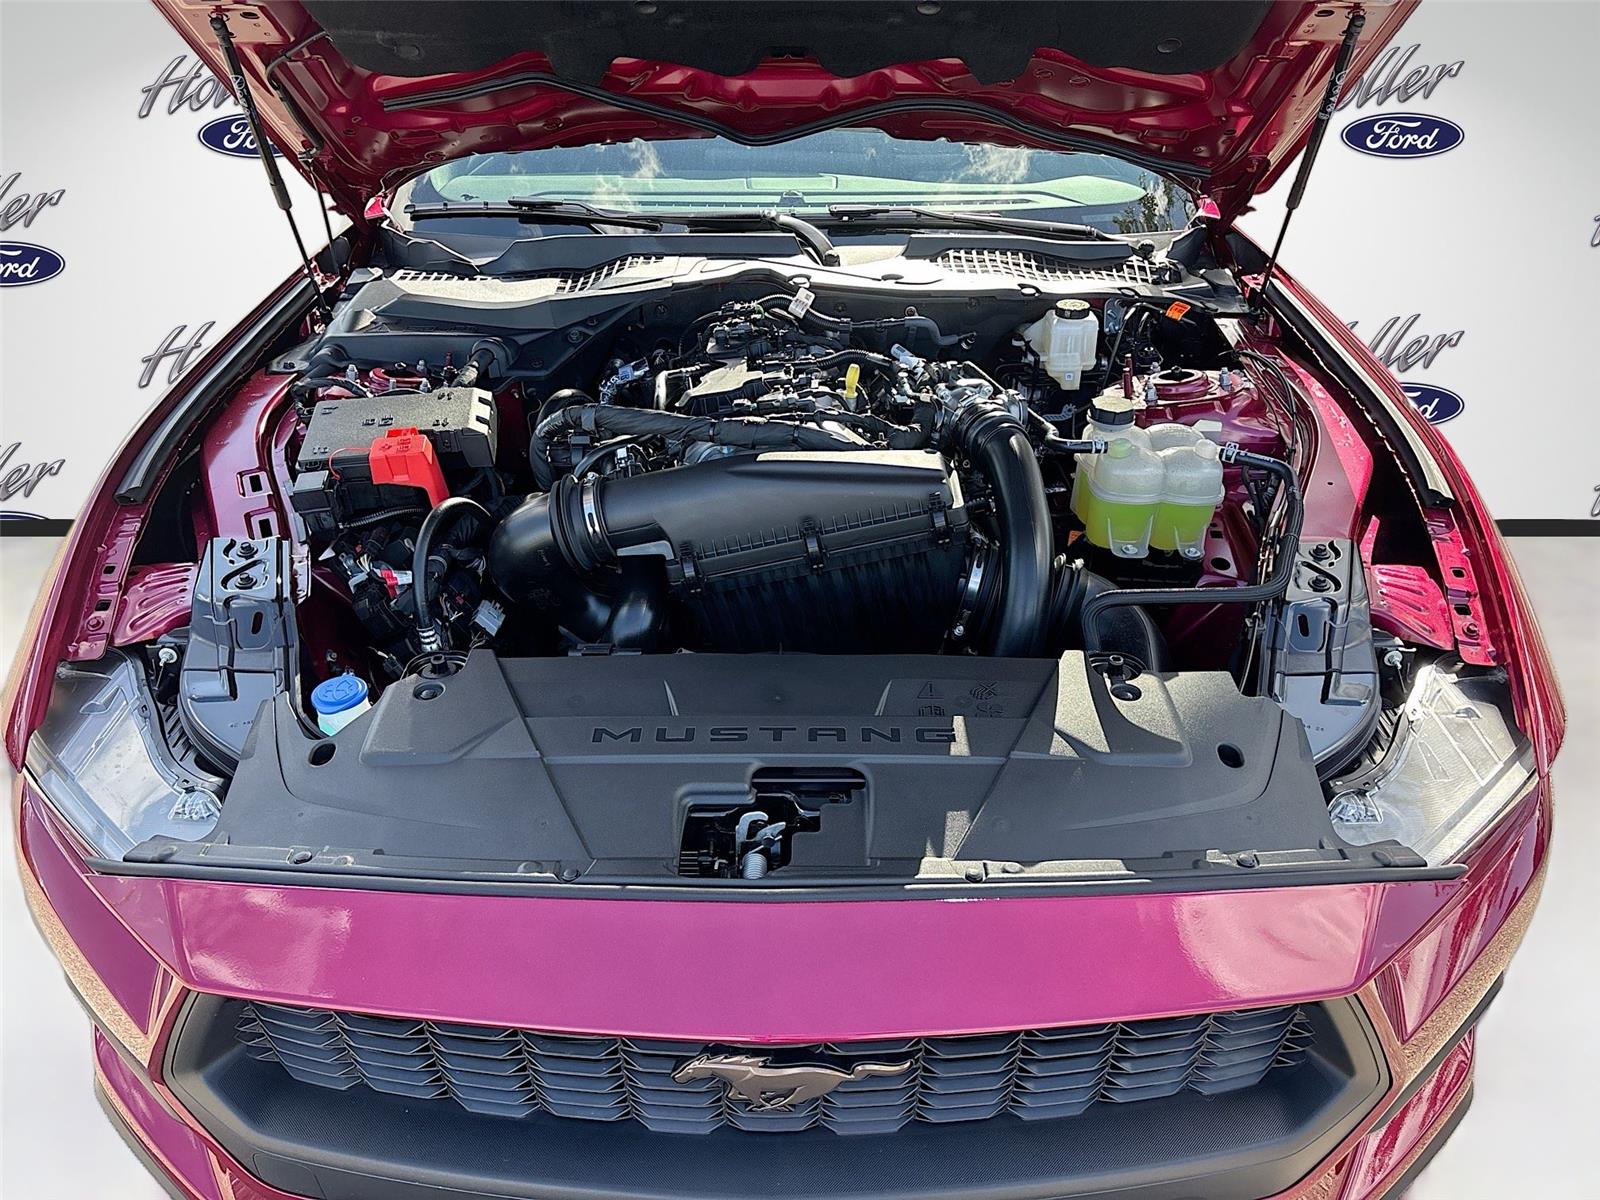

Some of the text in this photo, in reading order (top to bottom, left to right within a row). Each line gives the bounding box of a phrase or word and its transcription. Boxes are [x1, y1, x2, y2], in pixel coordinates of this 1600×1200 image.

[1365, 119, 1440, 150] Ford
[1346, 313, 1465, 373] ller
[591, 726, 957, 744] MUSTANG
